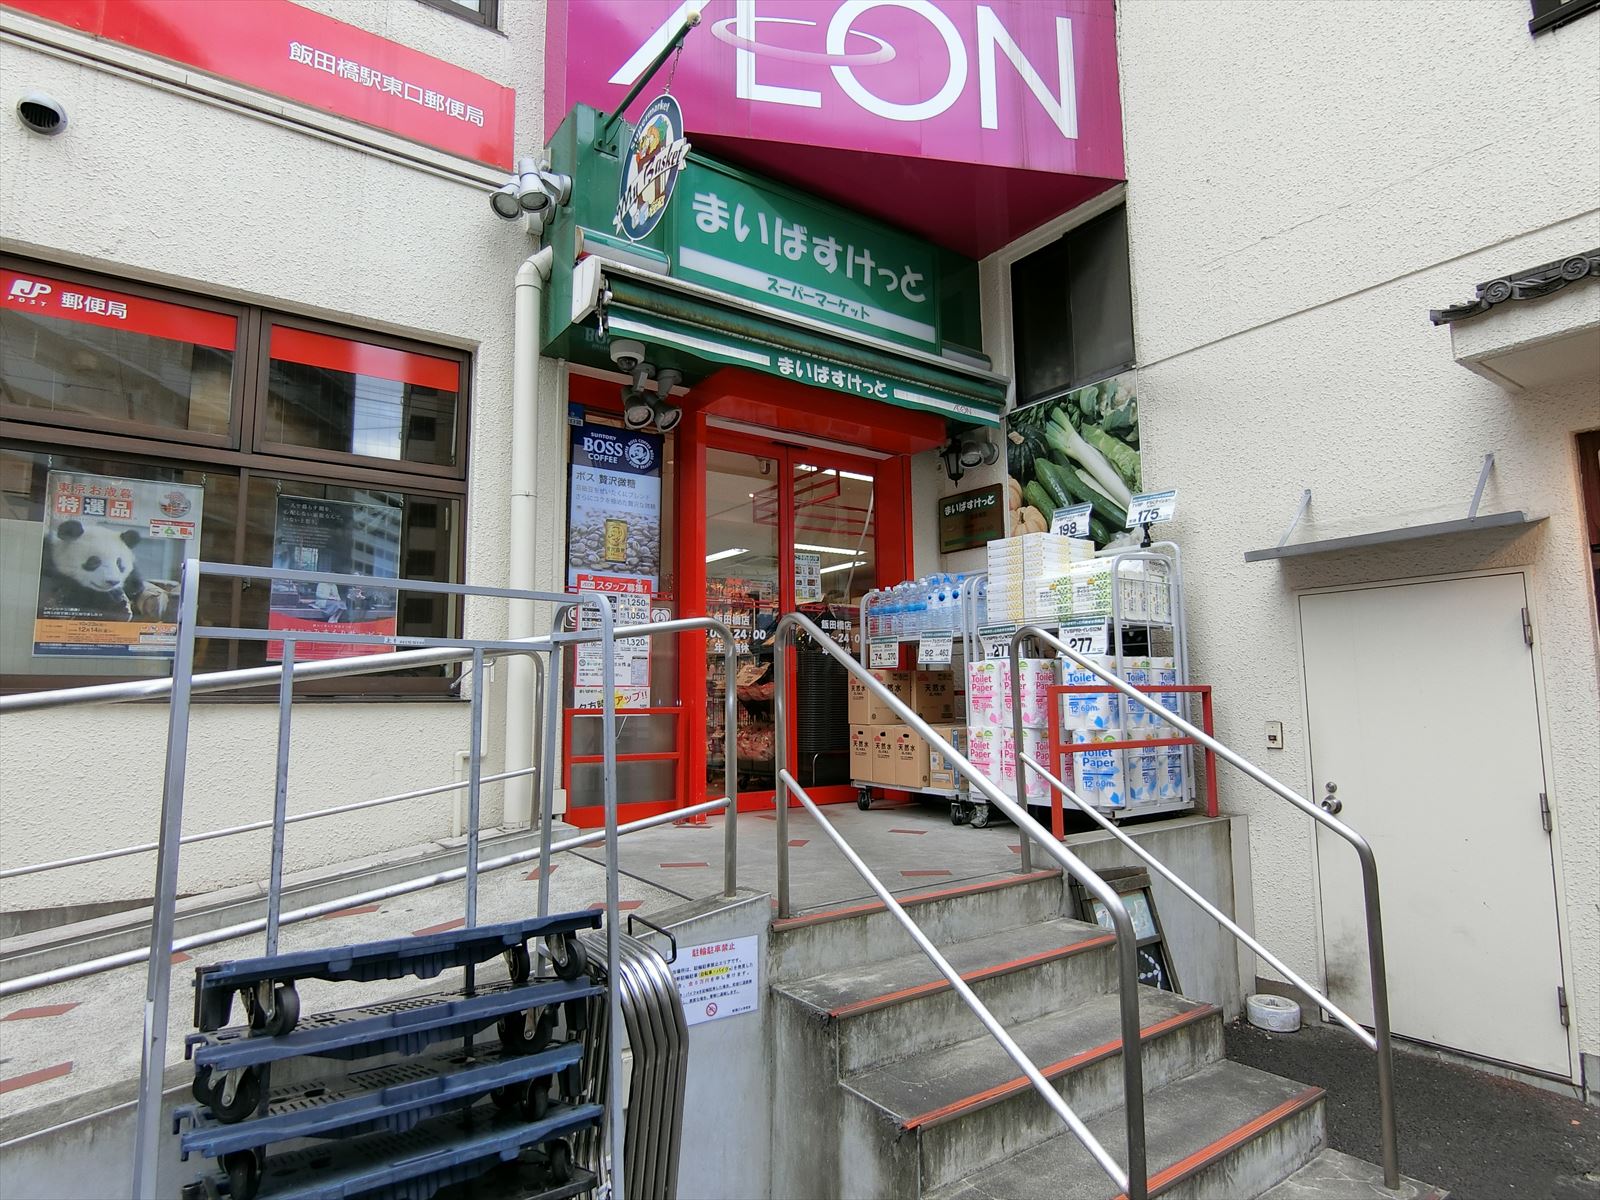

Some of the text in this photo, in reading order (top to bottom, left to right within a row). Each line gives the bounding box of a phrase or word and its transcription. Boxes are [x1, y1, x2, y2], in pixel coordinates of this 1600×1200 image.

[608, 0, 1078, 140] AEON
[288, 40, 485, 128] 飯田橋駅東口郵便局
[692, 191, 927, 303] まいばすけっと
[7, 295, 48, 307] POST
[767, 276, 870, 321] スーパーマーケット
[61, 292, 128, 319] 郵便局
[777, 356, 888, 399] まいばすけっと
[590, 432, 617, 441] SUNTORY
[583, 436, 623, 457] BOSS
[587, 452, 618, 464] COFFEE
[58, 495, 131, 518] 特選品
[944, 495, 995, 516] まいばすけっと
[1138, 508, 1160, 523] 175
[1059, 522, 1077, 536] 198
[821, 619, 852, 631] 飯田橋店
[714, 642, 750, 654] 年無休
[992, 643, 1010, 657] 277
[1069, 637, 1093, 652] 277
[924, 649, 934, 657] 92
[971, 674, 992, 683] Toilet
[1068, 673, 1097, 683] Toilet
[924, 683, 947, 692] 天然水
[971, 683, 993, 693] Paper
[852, 740, 870, 748] 天然水
[898, 744, 916, 752] 天然水
[970, 740, 990, 749] Toilet
[970, 749, 992, 759] Paper
[1082, 757, 1115, 768] Paper
